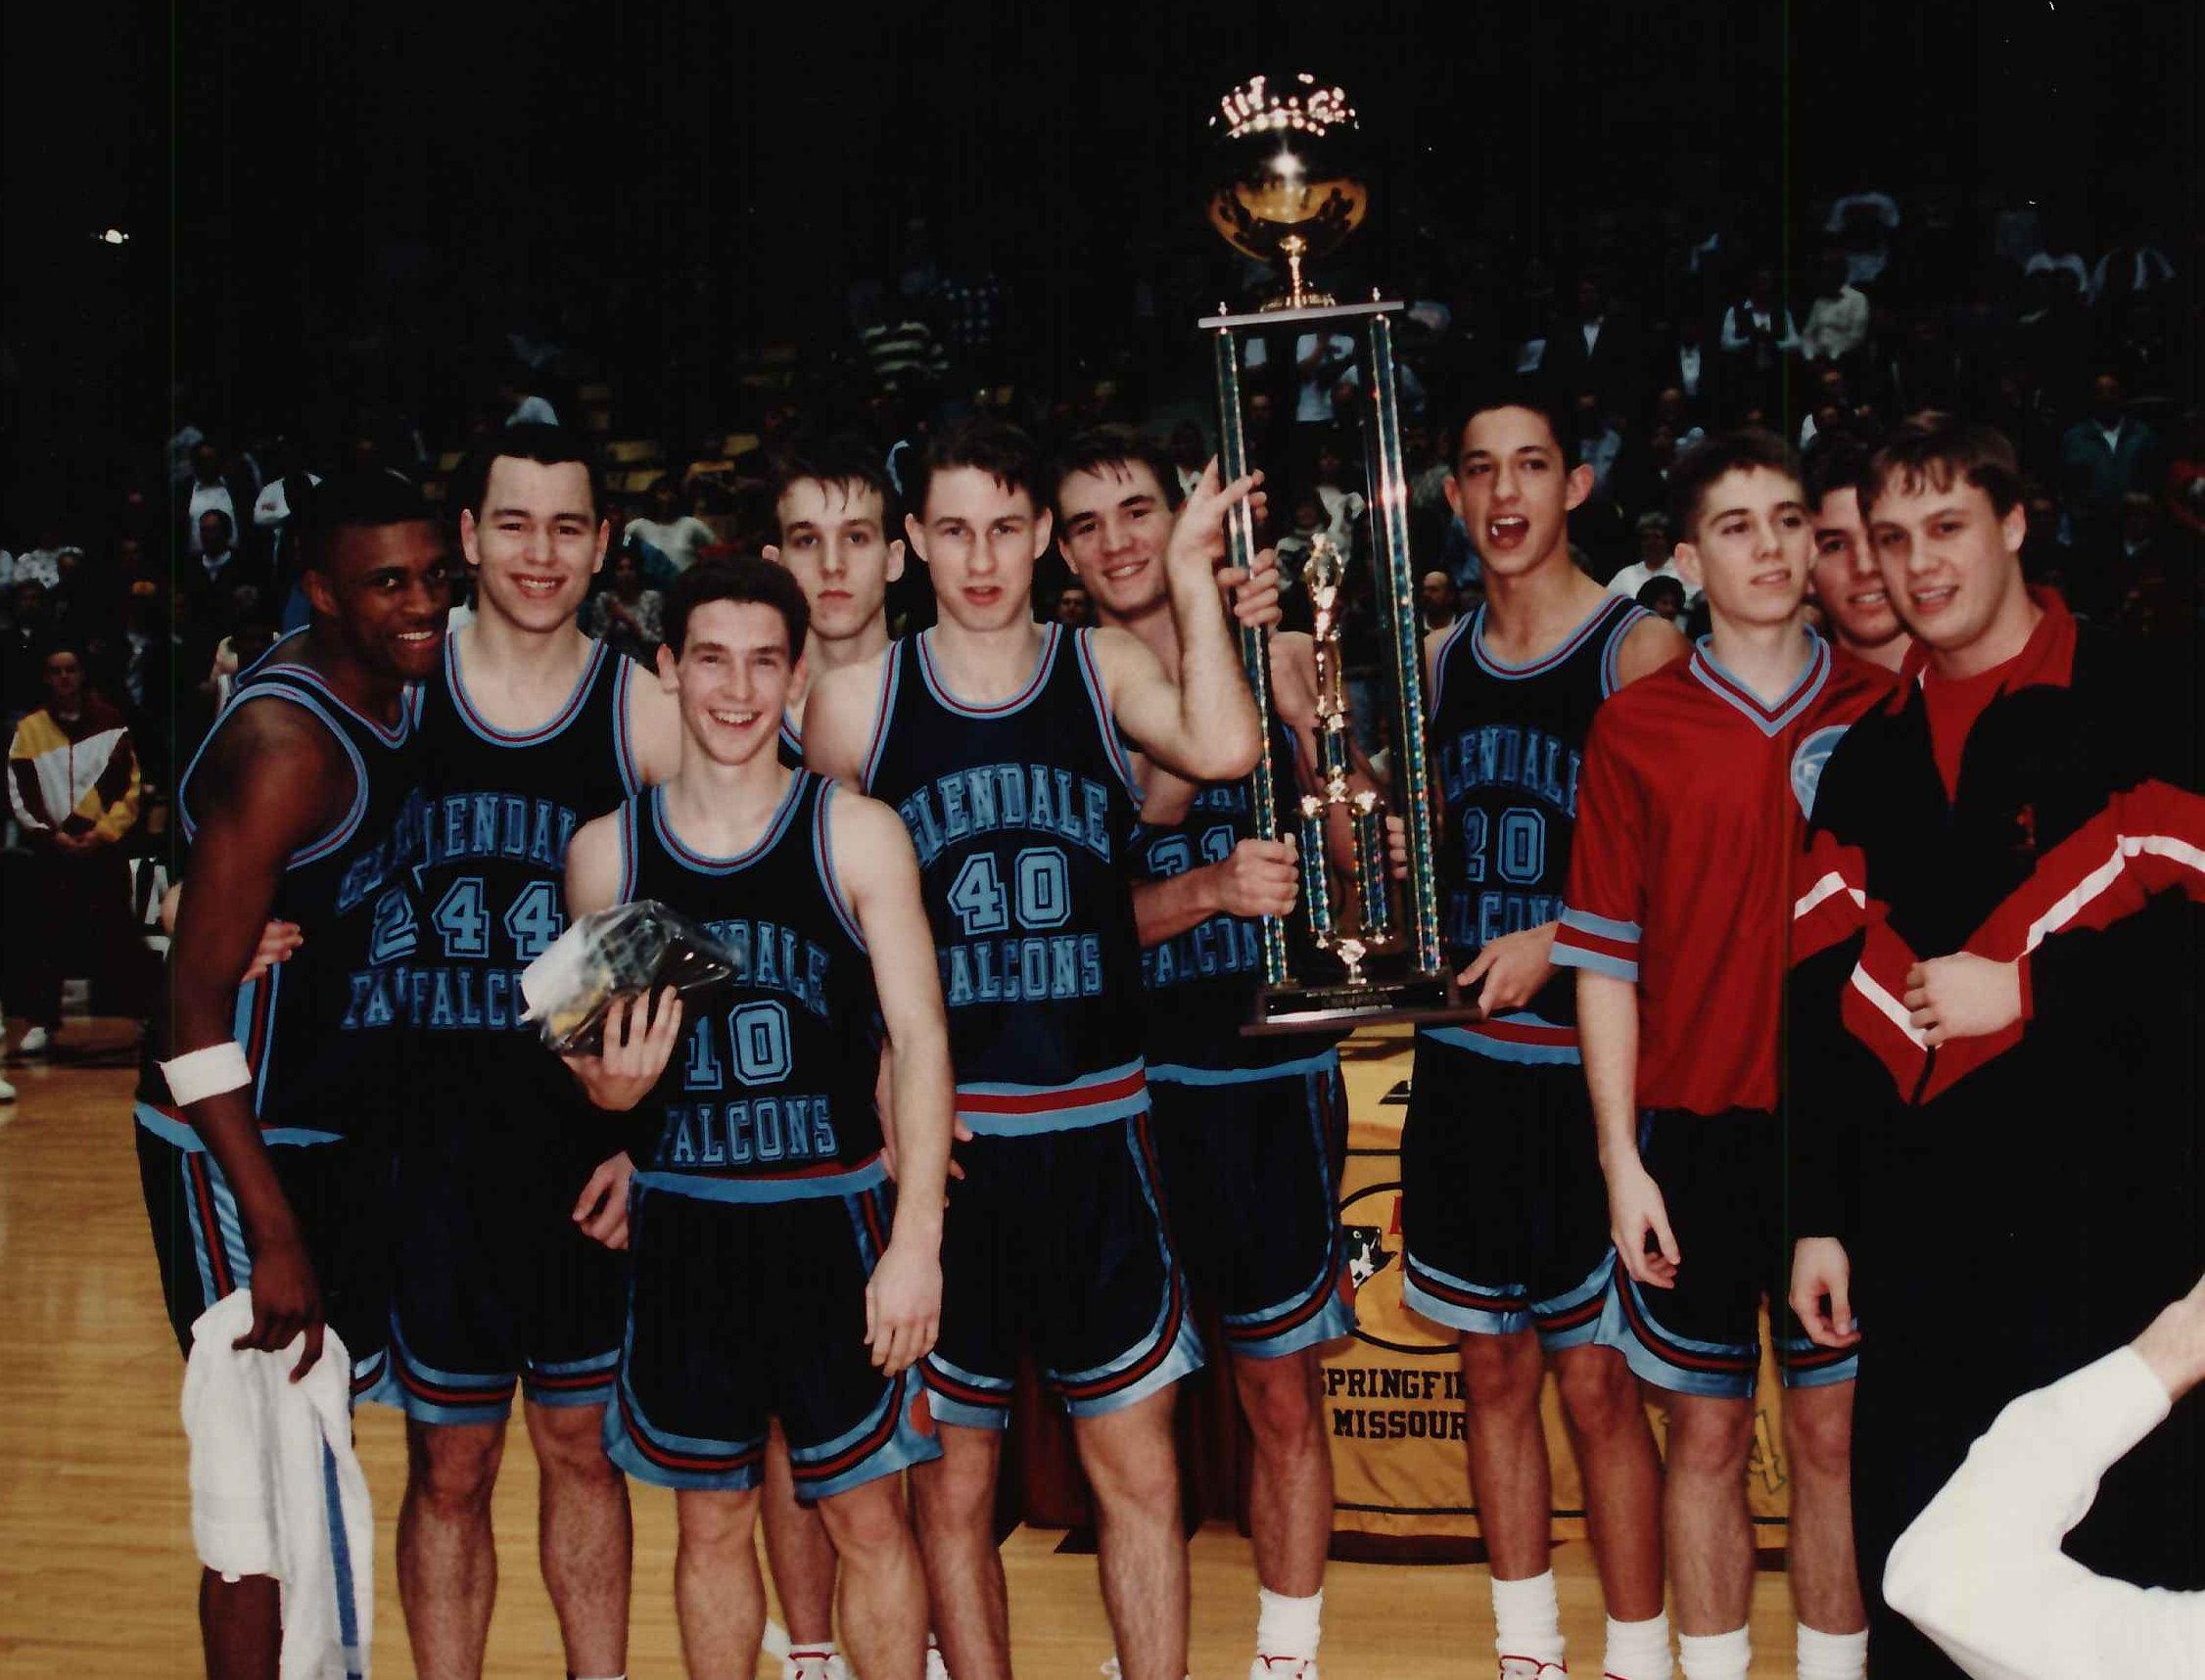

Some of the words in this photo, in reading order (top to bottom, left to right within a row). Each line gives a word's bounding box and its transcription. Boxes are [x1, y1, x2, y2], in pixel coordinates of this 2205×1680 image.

[431, 876, 566, 961] 44
[947, 845, 1072, 936] 40
[938, 933, 1104, 1007] ALCONS
[684, 998, 793, 1091] 10
[655, 1094, 840, 1167] FALCONS
[1333, 1408, 1468, 1441] MISSOUR
